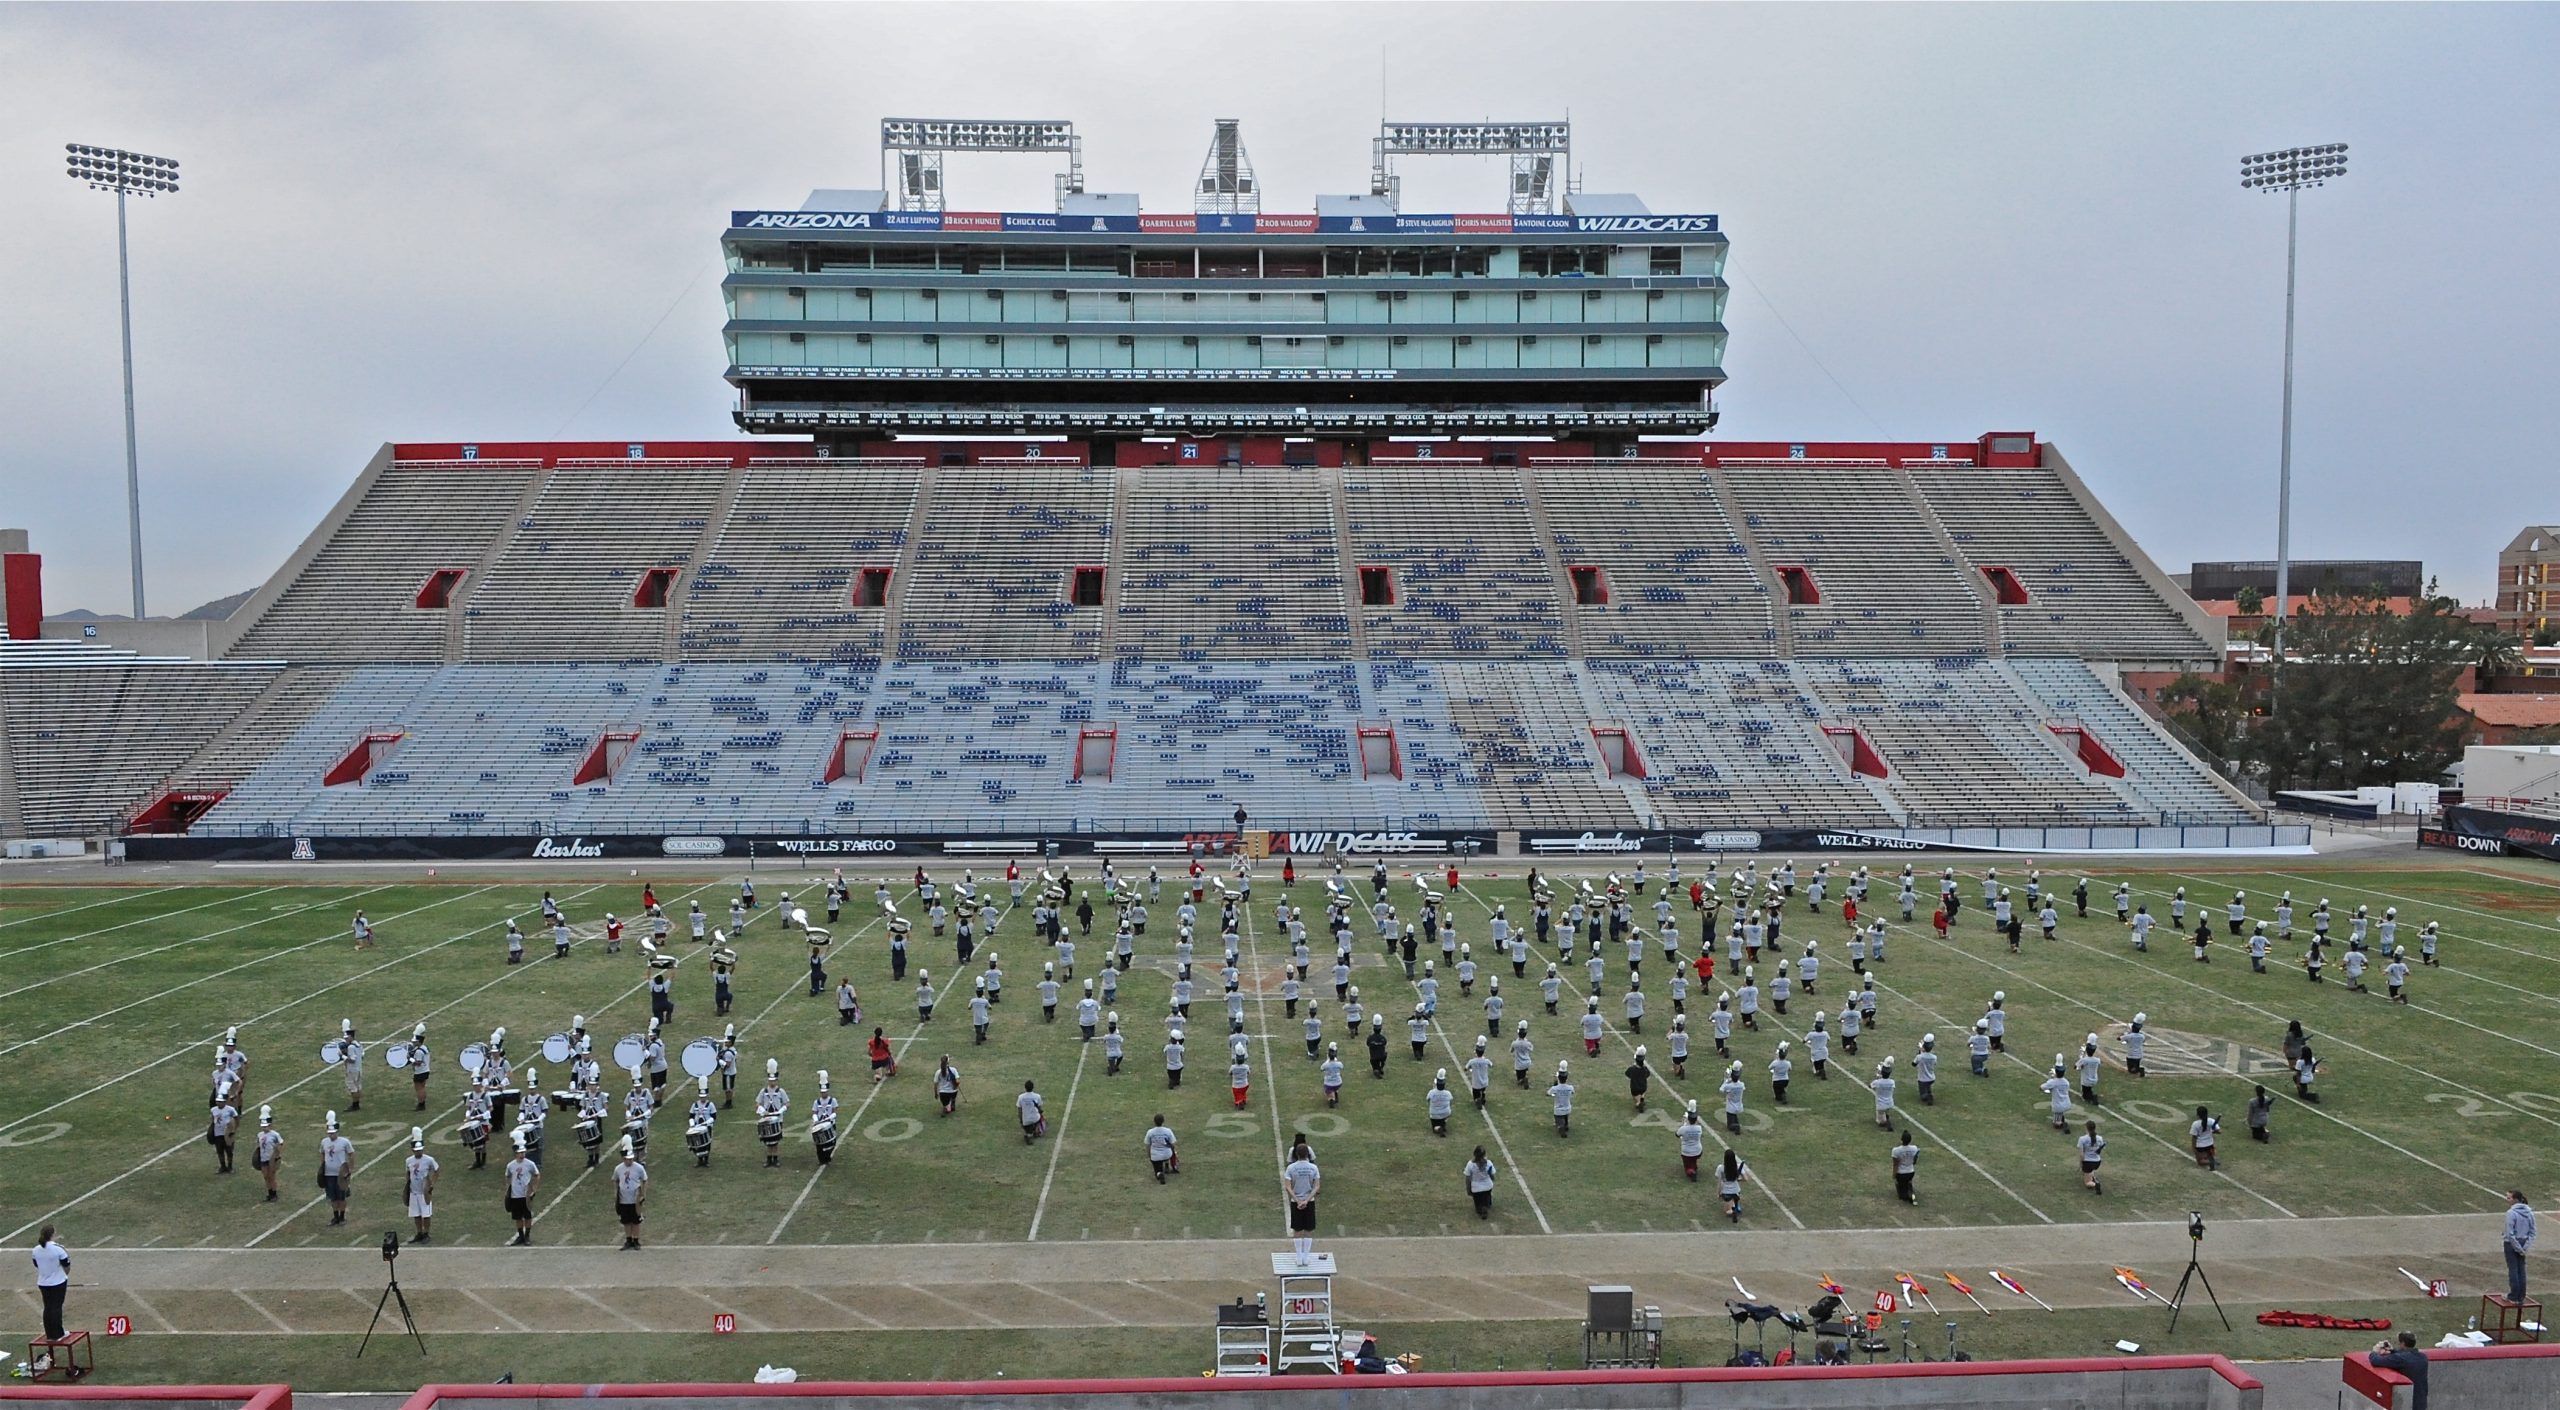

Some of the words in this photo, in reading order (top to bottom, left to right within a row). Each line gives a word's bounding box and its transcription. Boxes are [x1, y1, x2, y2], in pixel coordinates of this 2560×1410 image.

[746, 214, 871, 227] ARIZONA
[887, 216, 896, 224] 22
[910, 217, 940, 225] LUPPINO
[954, 217, 974, 225] RICKY
[975, 217, 1001, 225] HUNLEY
[1012, 218, 1036, 226] CHUCK
[1037, 218, 1056, 226] CECIL
[1176, 220, 1196, 228] LEWIS
[1547, 220, 1570, 228] CASON
[1578, 218, 1710, 230] WILDCATS
[464, 450, 476, 459] 17
[630, 449, 642, 458] 18
[817, 448, 829, 458] 19
[1026, 448, 1040, 458] 20
[1184, 448, 1196, 458] 21
[1418, 448, 1431, 458] 22
[1624, 448, 1637, 458] 23
[1792, 450, 1804, 458] 24
[1933, 450, 1946, 459] 25
[84, 626, 96, 636] 16
[1817, 835, 1870, 846] WELLS
[2505, 828, 2552, 844] ARIZONA
[784, 840, 839, 851] WELLS
[842, 840, 896, 851] FARGO
[2424, 832, 2457, 846] BEAR
[2458, 836, 2500, 852] DOWN
[292, 838, 315, 859] A
[532, 838, 604, 858] Bashas'
[1201, 1112, 1351, 1138] 50
[2432, 1280, 2448, 1297] 30
[1296, 1298, 1313, 1313] 50
[1877, 1293, 1892, 1312] 40
[109, 1318, 126, 1334] 30
[716, 1315, 732, 1332] 40
